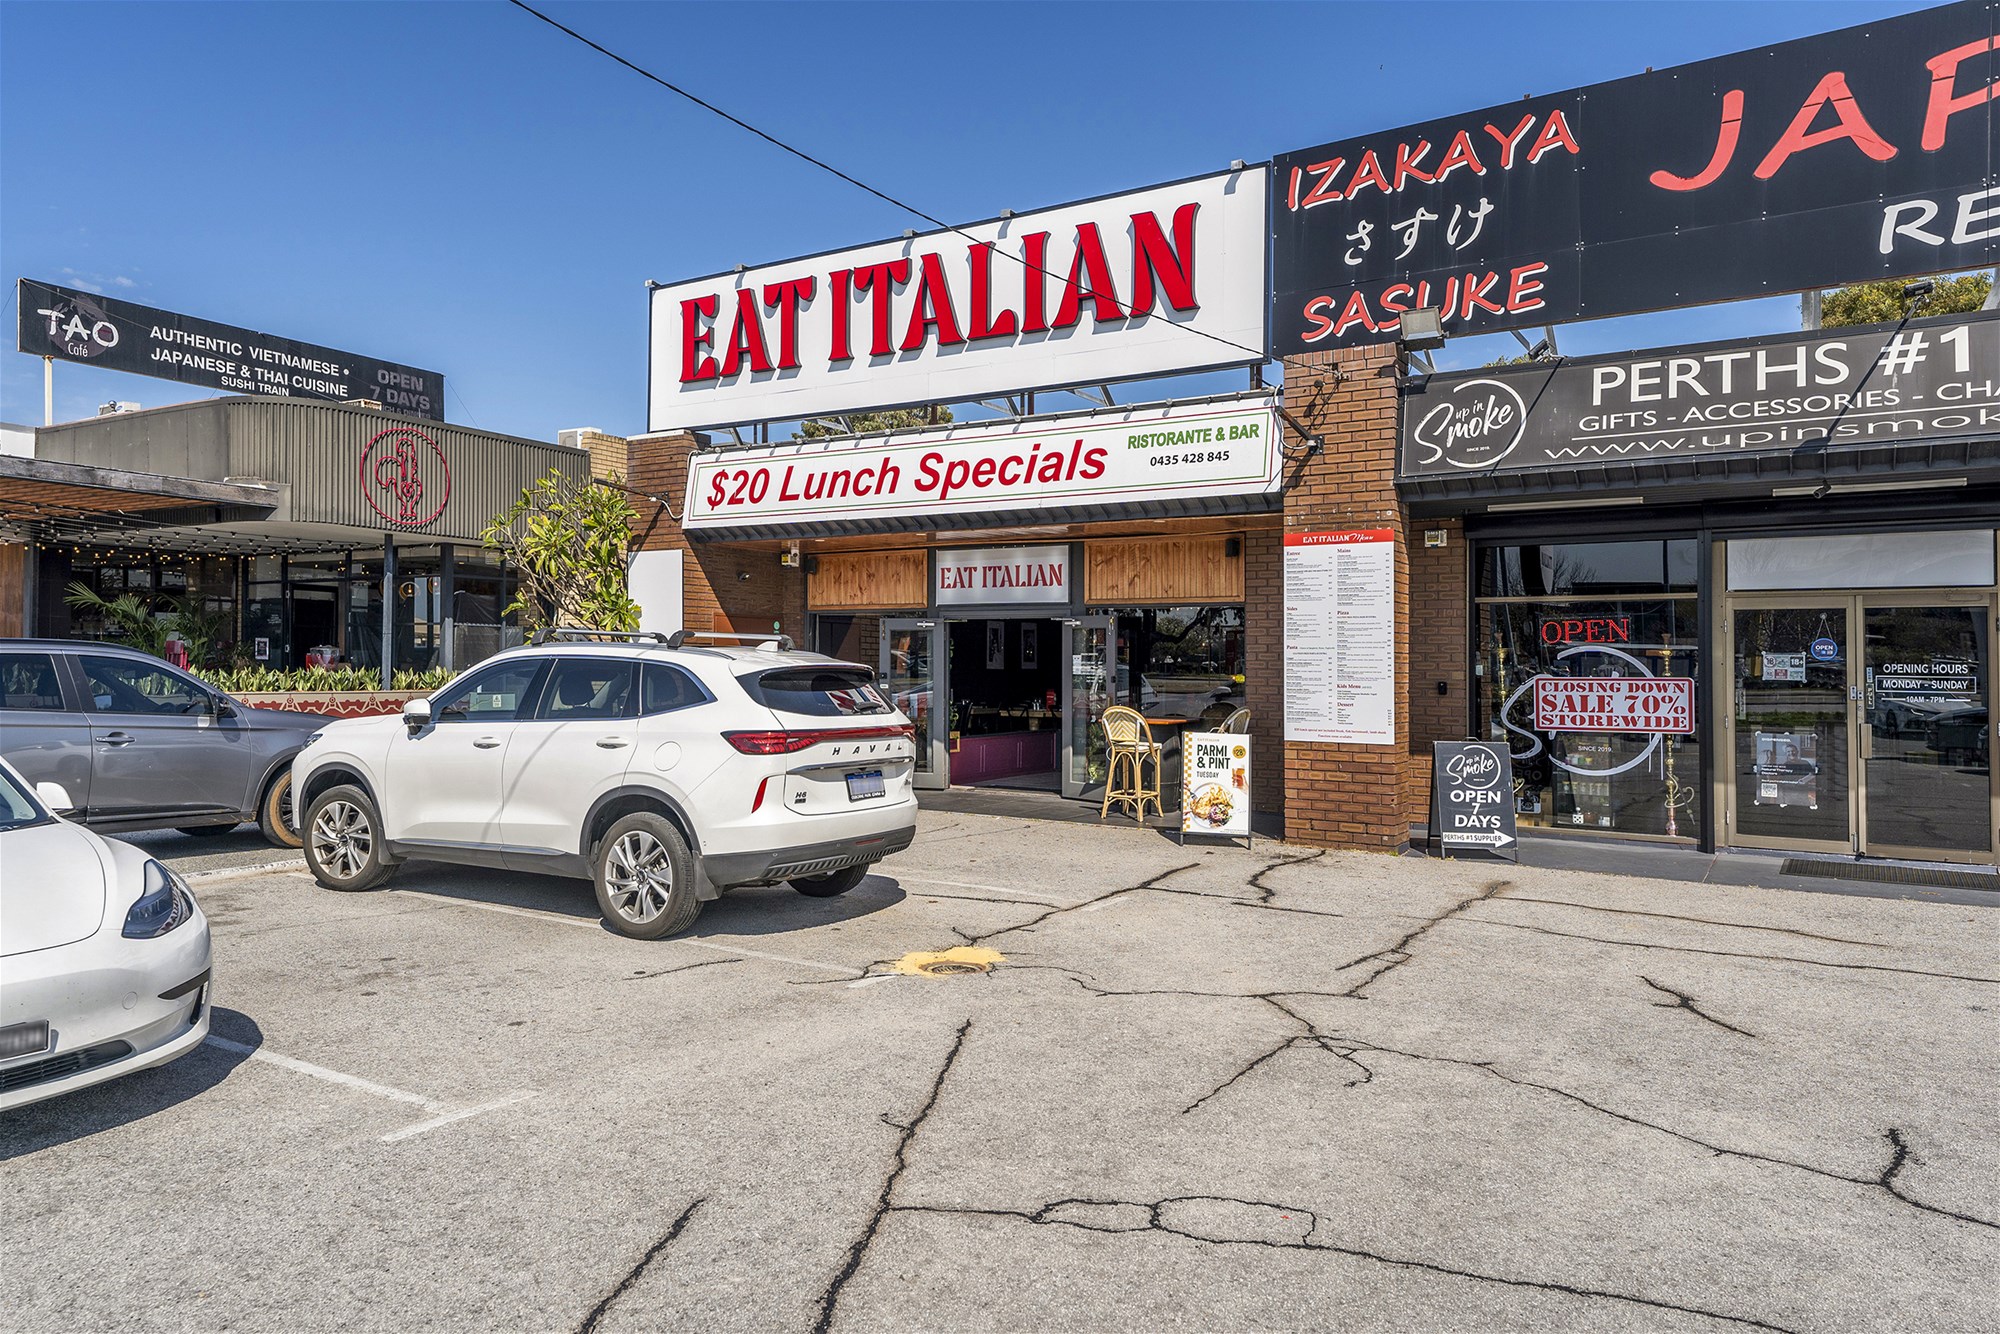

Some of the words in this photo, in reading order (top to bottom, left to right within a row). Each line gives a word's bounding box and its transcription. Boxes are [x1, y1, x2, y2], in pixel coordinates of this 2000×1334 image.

[1287, 109, 1580, 211] IZAKAYA
[1345, 197, 1495, 266] さすけ
[679, 275, 818, 384] EAT
[827, 202, 1202, 362] ITALIAN
[1300, 261, 1549, 344] SASUKE
[37, 308, 119, 347] TAO
[68, 342, 88, 357] Café
[150, 325, 242, 356] AUTHENTIC
[249, 346, 340, 377] VIETNAMESE
[150, 348, 236, 375] JAPANESE
[240, 365, 251, 378] &
[254, 367, 289, 385] THAI
[292, 375, 349, 397] CUISINE
[1592, 342, 1850, 406] PERTHS
[1877, 326, 1970, 376] #1
[221, 375, 255, 391] SUSHI
[257, 383, 290, 397] TRAIN
[377, 369, 424, 392] OPEN
[370, 385, 381, 400] 7
[386, 388, 431, 410] DAYS
[1579, 410, 1657, 433] GIFTS
[1682, 388, 1900, 421] ACCESSORIES
[1936, 380, 2000, 401] CH
[1455, 407, 1470, 421] up
[1473, 400, 1485, 414] in
[1127, 429, 1214, 450] RISTORANTE
[1215, 427, 1226, 442] &
[1228, 423, 1260, 442] BAR
[1414, 395, 1514, 464] Smoke
[1149, 453, 1180, 468] 0435
[1181, 452, 1205, 465] 428
[1207, 450, 1231, 463] 845
[707, 467, 770, 511] $20
[778, 457, 902, 503] Lunch
[913, 438, 1109, 501] Specials
[1319, 534, 1350, 542] ITALIAN
[939, 566, 979, 590] EAT
[982, 563, 1063, 589] ITALIAN
[1541, 618, 1629, 644] OPEN
[1883, 664, 1929, 674] OPENING
[1931, 664, 1969, 674] HOURS
[1541, 681, 1621, 693] CLOSING
[1628, 683, 1686, 694] DOWN
[1882, 680, 1922, 689] MONDAY
[1931, 680, 1968, 690] SUNDAY
[1541, 694, 1614, 713] SALE
[1624, 695, 1686, 715] 70%
[1541, 715, 1687, 728] STOREWIDE
[832, 743, 903, 756] HAVAL
[1197, 744, 1228, 757] PARMI
[1197, 756, 1206, 769] &
[1209, 757, 1231, 769] PINT
[1446, 753, 1495, 785] Smoke
[795, 791, 807, 799] H6
[1450, 790, 1502, 803] OPEN
[1471, 803, 1481, 815] 7
[1454, 815, 1501, 828] DAYS
[1474, 834, 1502, 842] SUPPLIER
